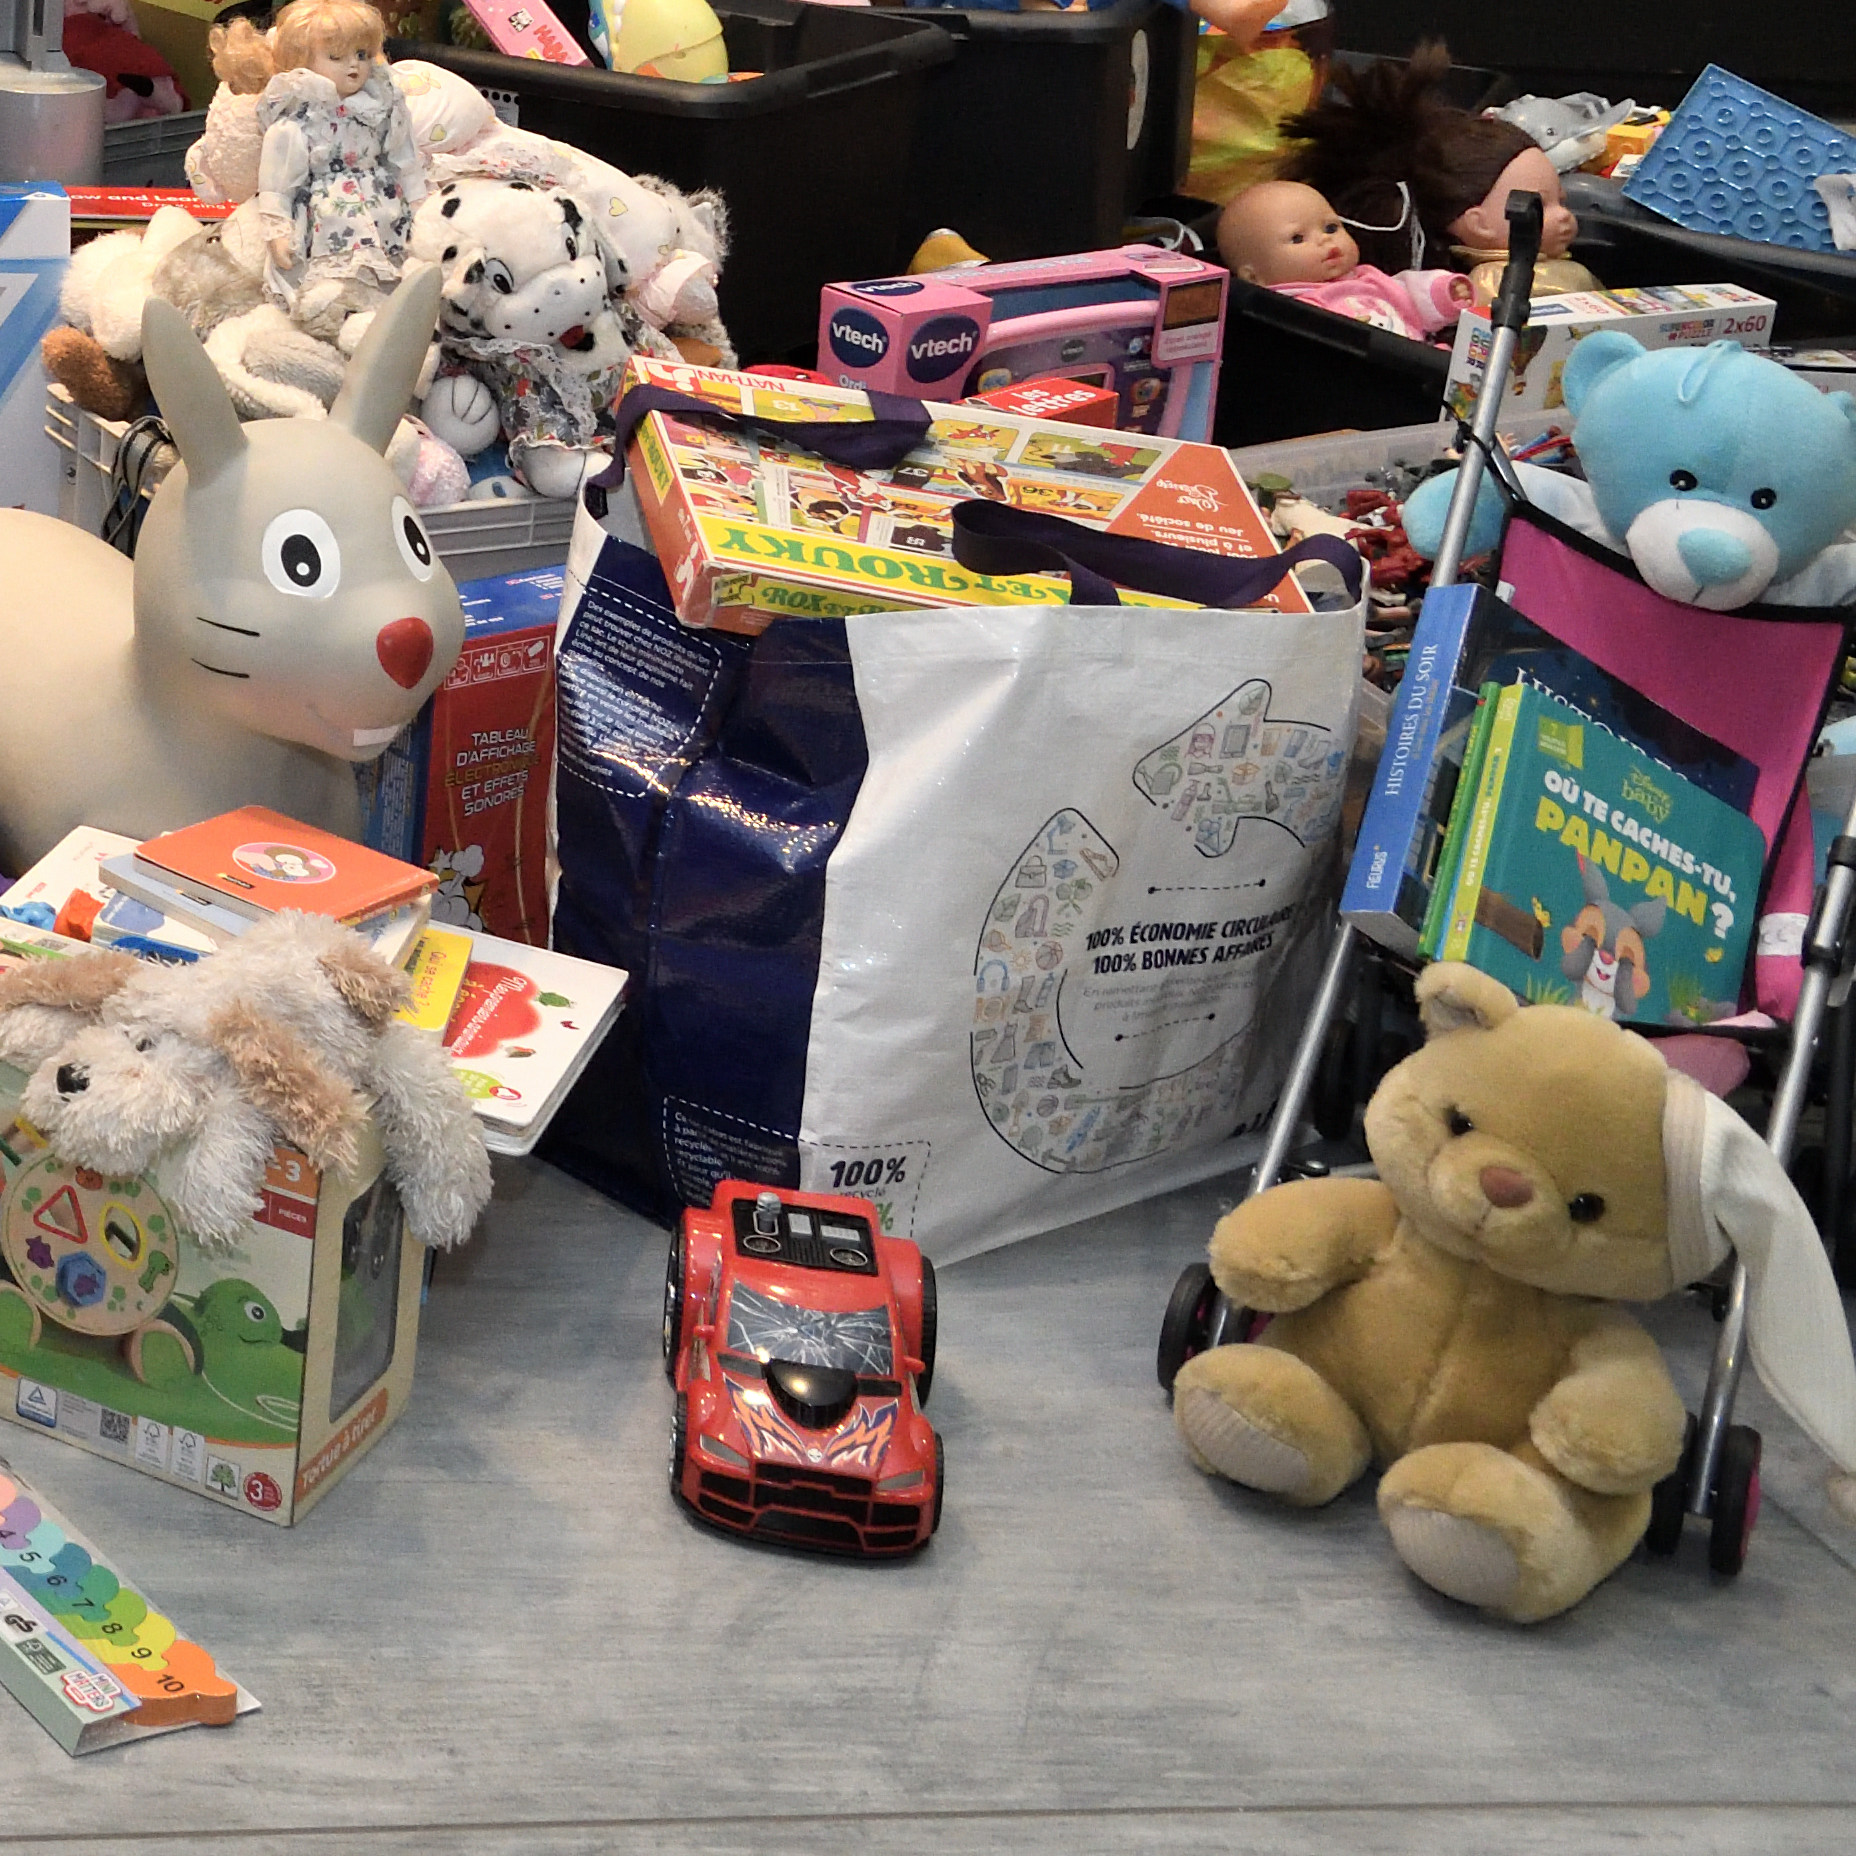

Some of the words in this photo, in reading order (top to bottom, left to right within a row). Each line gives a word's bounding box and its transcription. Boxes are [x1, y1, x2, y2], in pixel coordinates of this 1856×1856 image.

[832, 322, 885, 354] vtech
[1723, 314, 1768, 335] 2x60
[911, 331, 974, 360] vtech
[698, 369, 785, 392] NATHAN
[1009, 387, 1096, 417] lettres
[1196, 521, 1215, 532] de
[719, 527, 956, 588] ROUKY
[1385, 710, 1419, 797] HISTOIRES
[1418, 642, 1439, 681] SOIR
[471, 727, 530, 744] TABLEAU
[456, 742, 536, 767] D'AFFICHAGE
[461, 784, 480, 800] ET
[483, 771, 529, 795] EFFETS
[463, 786, 525, 817] SONORES
[1542, 767, 1576, 797] OÙ
[1580, 787, 1608, 815] TE
[1610, 808, 1739, 902] CACHES-TU,
[1534, 797, 1708, 927] PANPAN
[1086, 925, 1125, 952] 100%
[1130, 918, 1218, 945] ÉCONOMIE
[1093, 949, 1137, 975] 100%
[1141, 945, 1208, 971] BONNES
[829, 1155, 907, 1189] 100%
